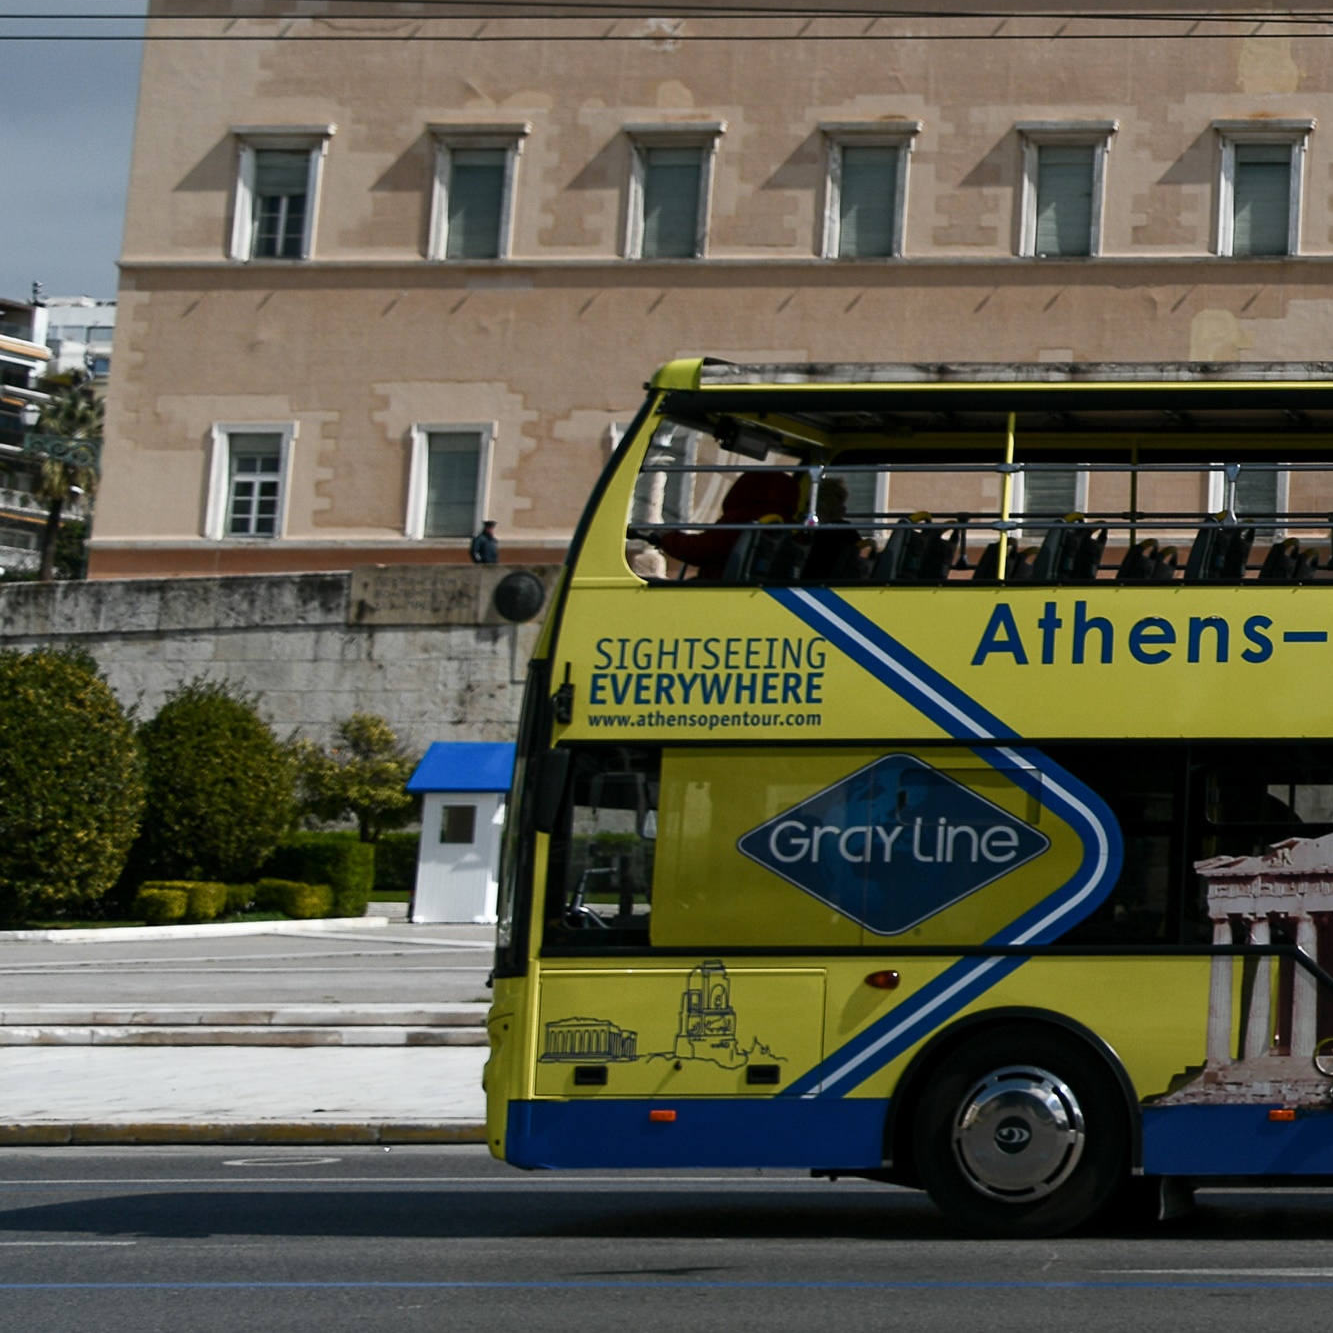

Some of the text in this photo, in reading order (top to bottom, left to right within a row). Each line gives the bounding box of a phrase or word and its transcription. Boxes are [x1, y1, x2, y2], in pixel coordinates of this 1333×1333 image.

[593, 637, 827, 671] SIGHTSEEING
[588, 671, 825, 706] EVERYWHERE
[588, 710, 822, 731] www.athensopentour.com
